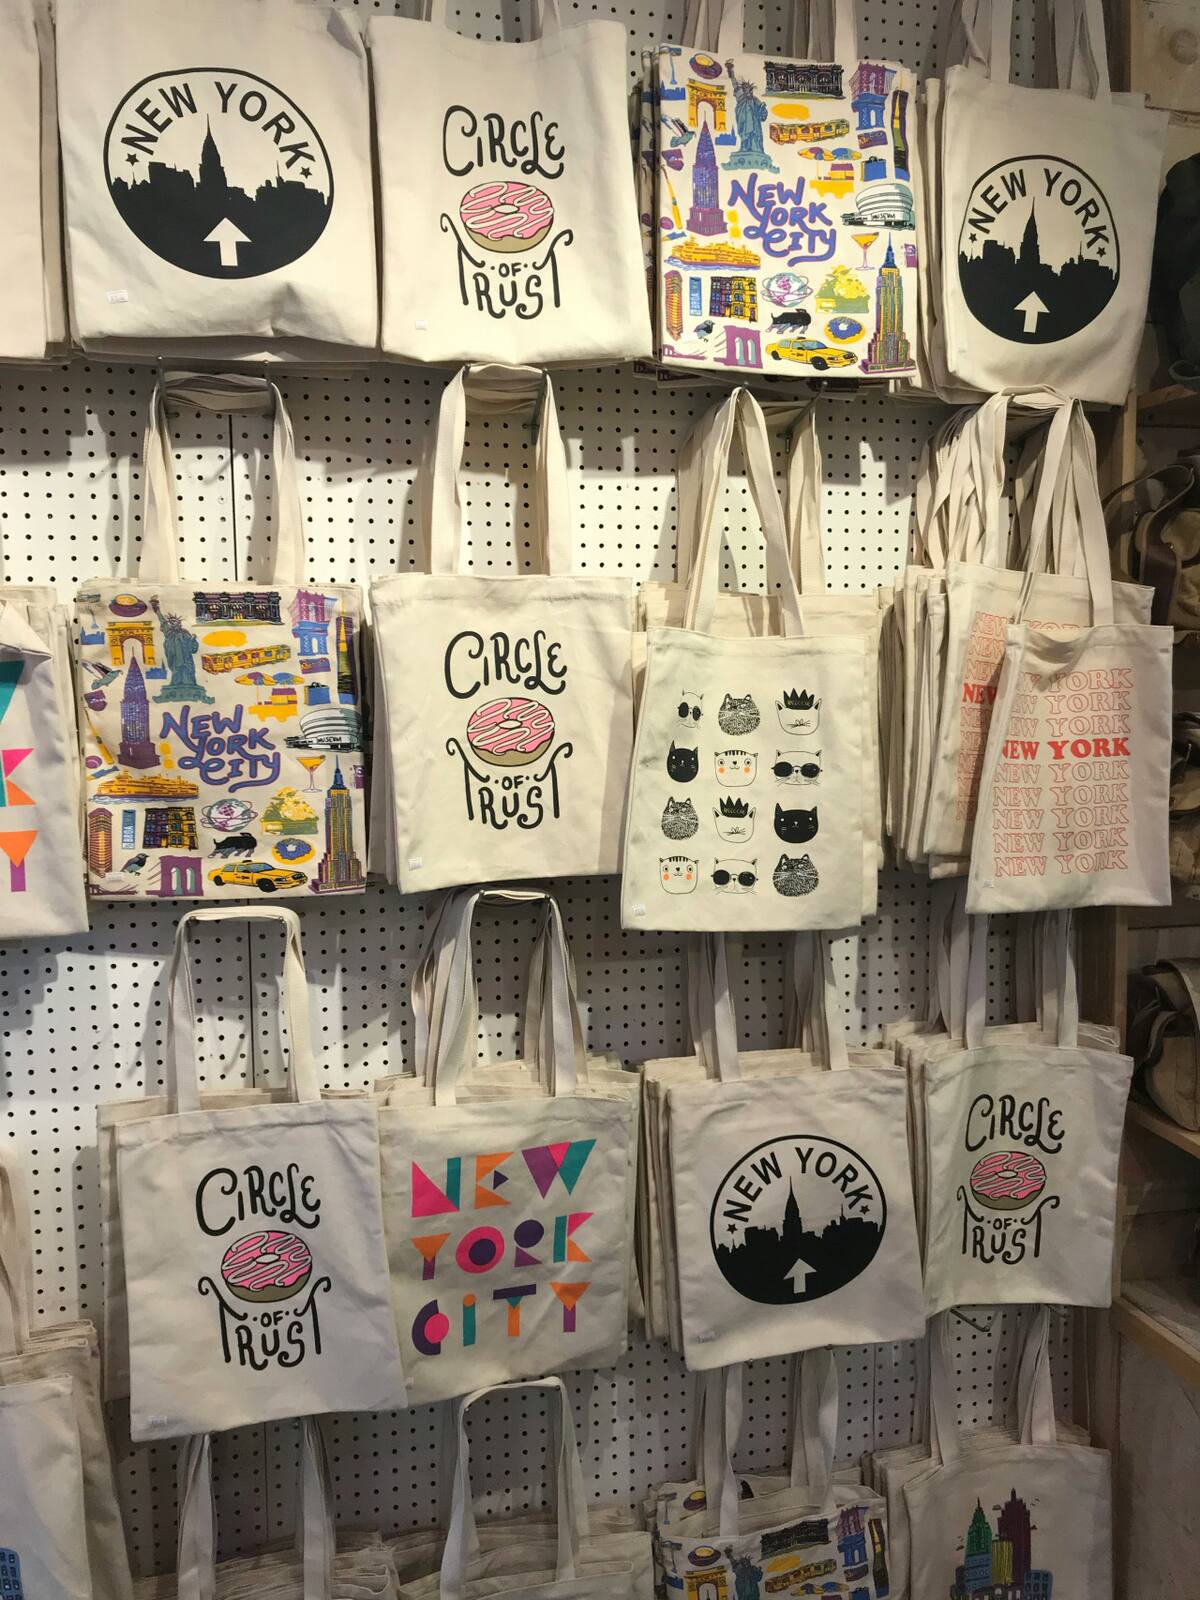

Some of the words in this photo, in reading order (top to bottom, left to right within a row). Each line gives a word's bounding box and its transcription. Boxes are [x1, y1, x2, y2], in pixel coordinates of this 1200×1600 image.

[121, 82, 198, 156] NEW
[214, 81, 316, 169] YORK
[443, 105, 565, 179] CIRCLE
[728, 173, 805, 220] NEW
[967, 168, 1027, 235] NEW
[1043, 168, 1110, 249] YORK
[743, 200, 833, 239] YORK
[440, 213, 573, 319] TRUST
[498, 262, 522, 277] OF
[762, 228, 837, 267] CITY
[444, 630, 567, 699] CIRCLE
[1044, 691, 1132, 714] YORK
[159, 704, 243, 752] NEW
[177, 727, 276, 769] YORK
[1045, 714, 1131, 738] YORK
[1047, 737, 1131, 760] YORK
[200, 752, 280, 793] CITY
[446, 737, 573, 830] TRUST
[501, 776, 524, 790] OF
[994, 763, 1041, 784] NEW
[1048, 760, 1129, 783] YORK
[992, 786, 1042, 807] NEW
[1049, 783, 1129, 806] YORK
[992, 809, 1044, 829] NEW
[1051, 804, 1129, 828] YORK
[993, 832, 1045, 853] NEW
[1052, 827, 1129, 851] YORK
[994, 856, 1048, 877] NEW
[965, 1094, 1065, 1154] CIRCLE
[196, 1163, 321, 1236] CIRCLE
[411, 1139, 597, 1218] NEW
[723, 1151, 783, 1223] NEW
[794, 1147, 873, 1209] YORK
[411, 1212, 594, 1280] YORK
[957, 1185, 1060, 1265] TRUST
[993, 1218, 1013, 1230] OF
[198, 1276, 332, 1371] TRUST
[260, 1311, 284, 1327] OF
[412, 1282, 592, 1356] CITY
